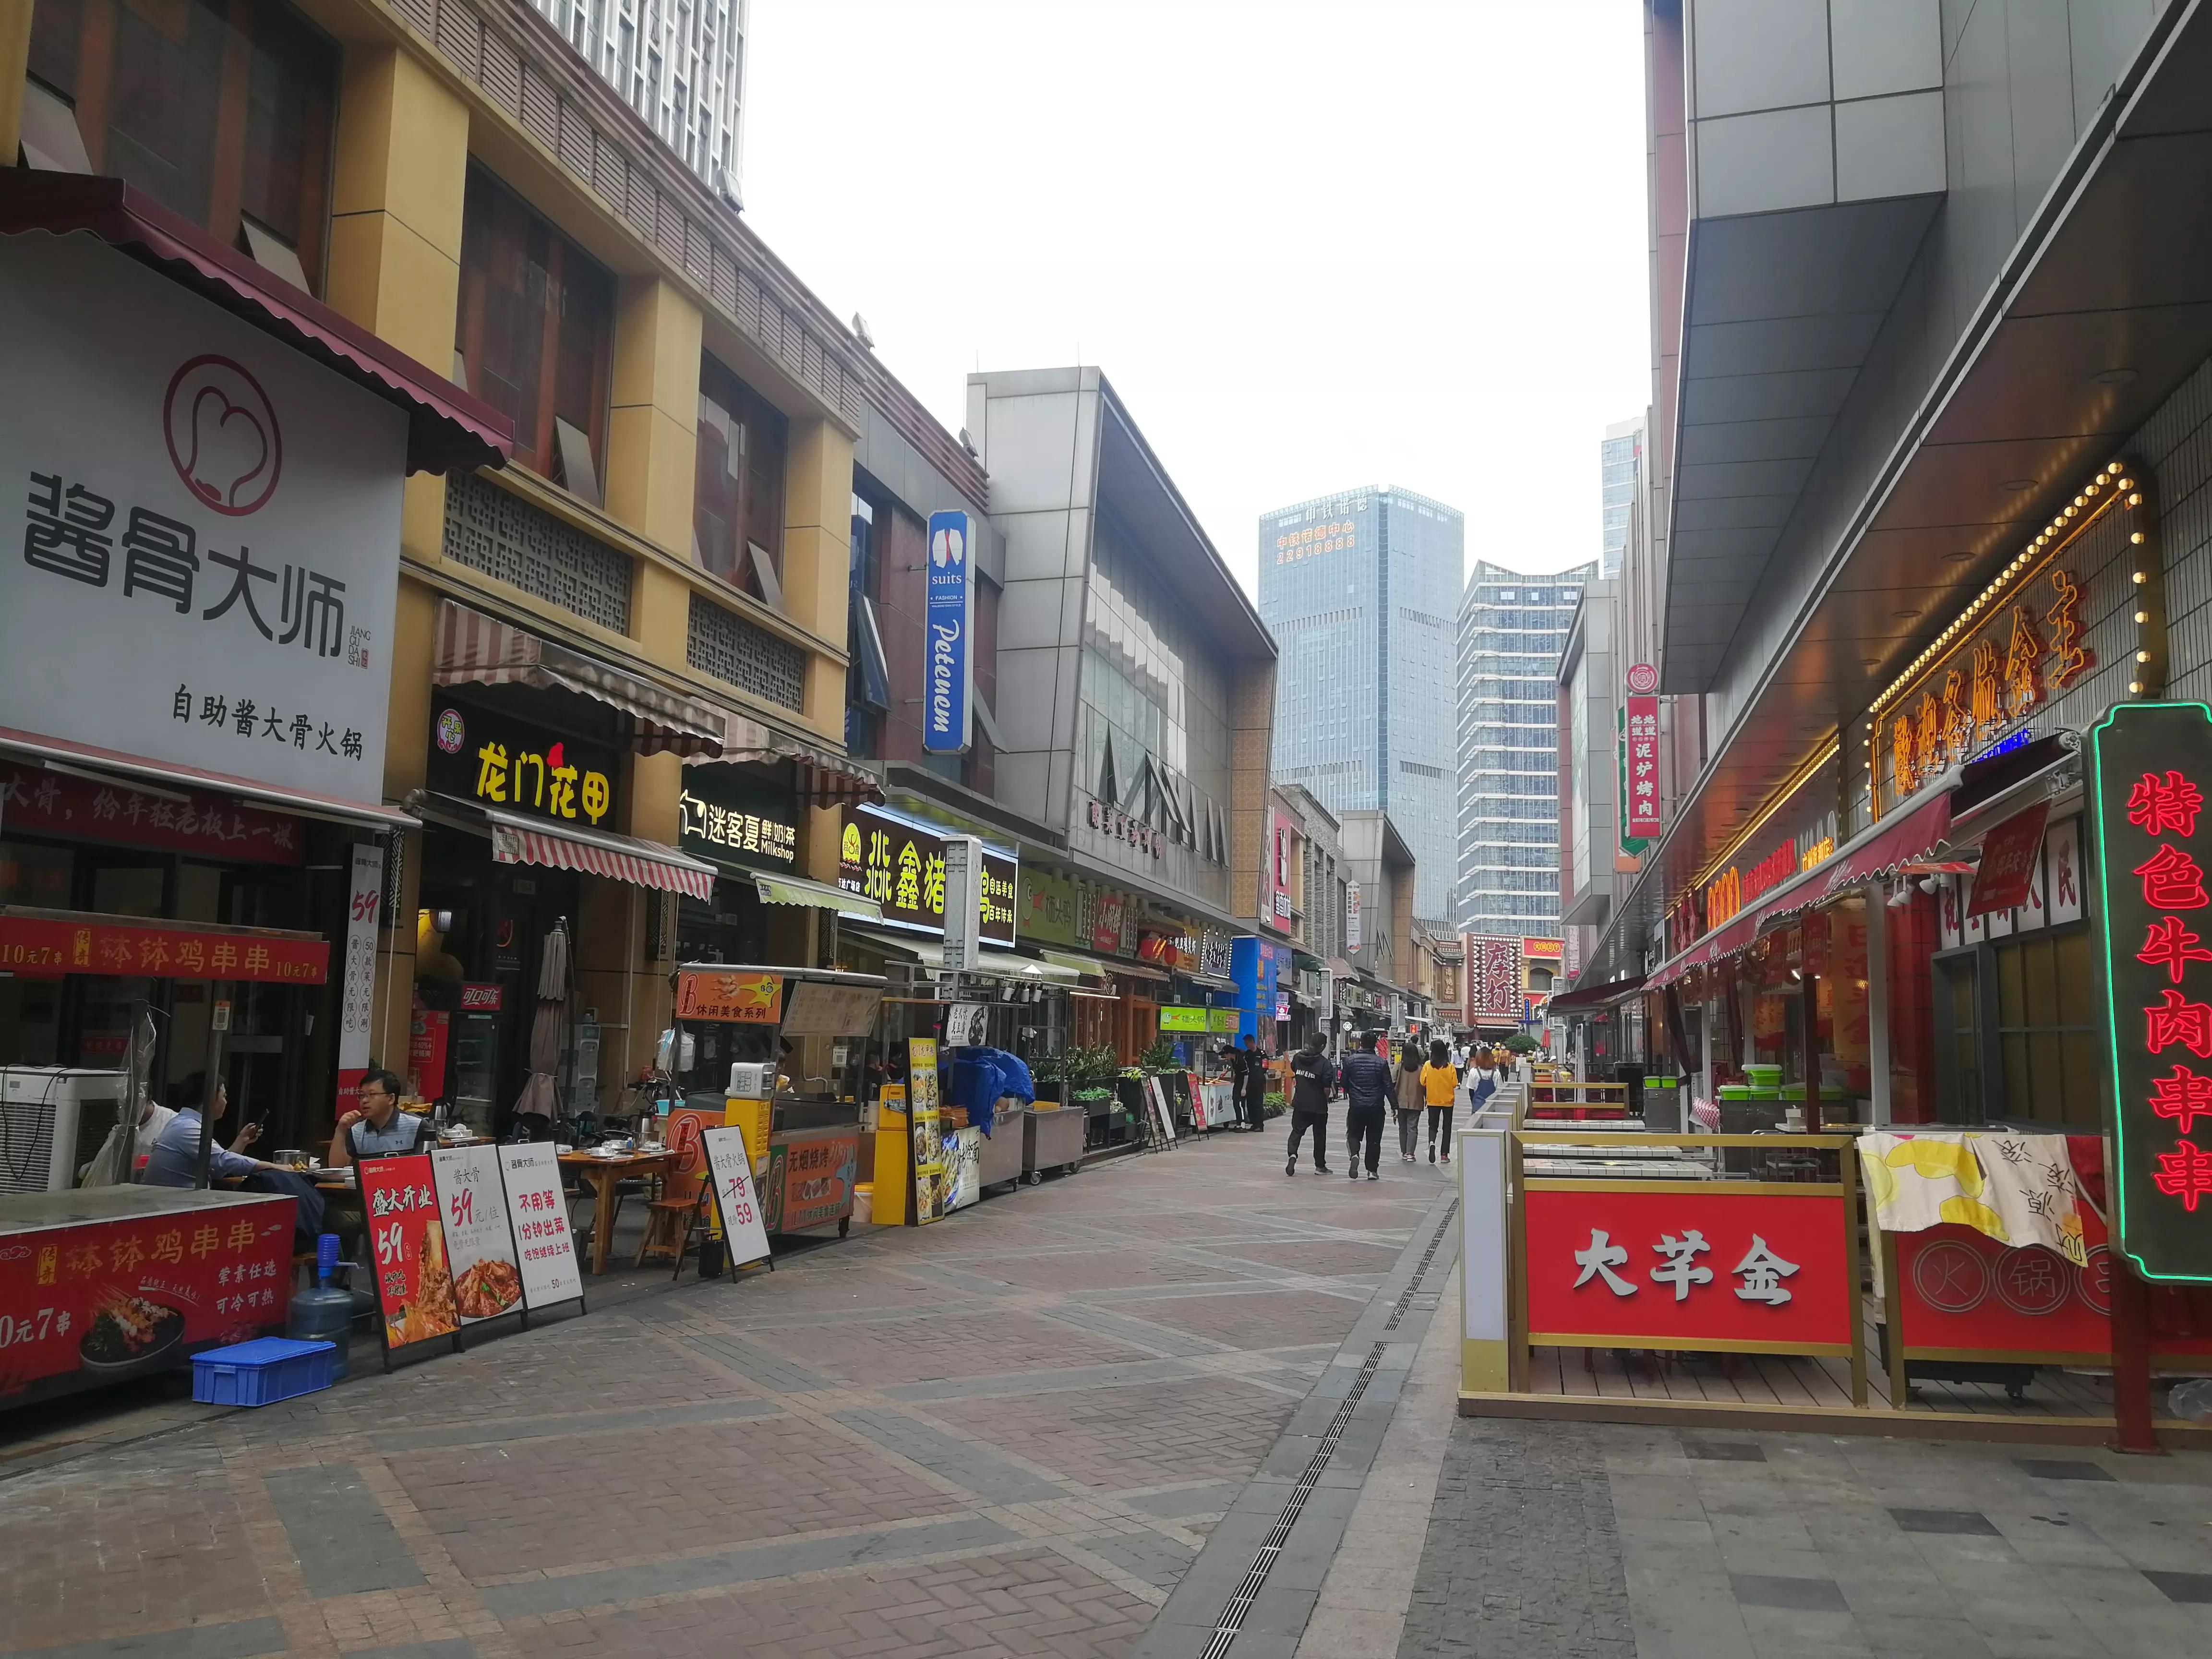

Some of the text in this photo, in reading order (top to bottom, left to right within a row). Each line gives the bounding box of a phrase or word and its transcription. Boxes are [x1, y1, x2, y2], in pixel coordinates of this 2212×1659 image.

[1277, 520, 1355, 551] 中铁诺德中心
[1276, 535, 1355, 565] 22918888
[24, 470, 346, 658] 酱骨大师
[932, 571, 962, 585] suits
[349, 635, 360, 647] GU
[350, 625, 371, 640] JIANG
[348, 655, 360, 667] SHI
[349, 645, 359, 657] DA
[173, 684, 363, 761] 自助酱大骨火锅
[476, 741, 610, 825] 龙门花甲
[1635, 743, 1653, 816] 泥炉烤肉
[708, 804, 760, 853] 迷客夏
[761, 838, 794, 864] Milkshop
[352, 889, 380, 924] 59
[989, 903, 1013, 925] 百年传承
[2, 943, 63, 965] 10元7串
[276, 962, 318, 979] 10元7串
[345, 937, 360, 1029] 酱大骨无限吃
[1485, 942, 1510, 1010] 摩打
[463, 987, 500, 1006] 可口可乐
[2127, 770, 2212, 1212] 特色牛肉串串
[696, 1004, 767, 1019] 休闲美食系列
[511, 1157, 535, 1169] 酱骨大师
[713, 1152, 745, 1171] 酱大骨火锅
[788, 1146, 830, 1173] 无烟烧烤
[453, 1166, 480, 1185] 酱大骨
[373, 1184, 433, 1217] 盛大开业
[451, 1188, 499, 1227] 59 元/位
[518, 1189, 555, 1213] 不用等
[735, 1202, 753, 1225] 59
[518, 1216, 565, 1241] 1分钟出菜
[377, 1222, 404, 1265] 59
[524, 1242, 570, 1262] 吃饱继续上班
[217, 1258, 277, 1287] 荤素任选
[551, 1278, 560, 1289] 50
[216, 1288, 274, 1315] 可冷可热
